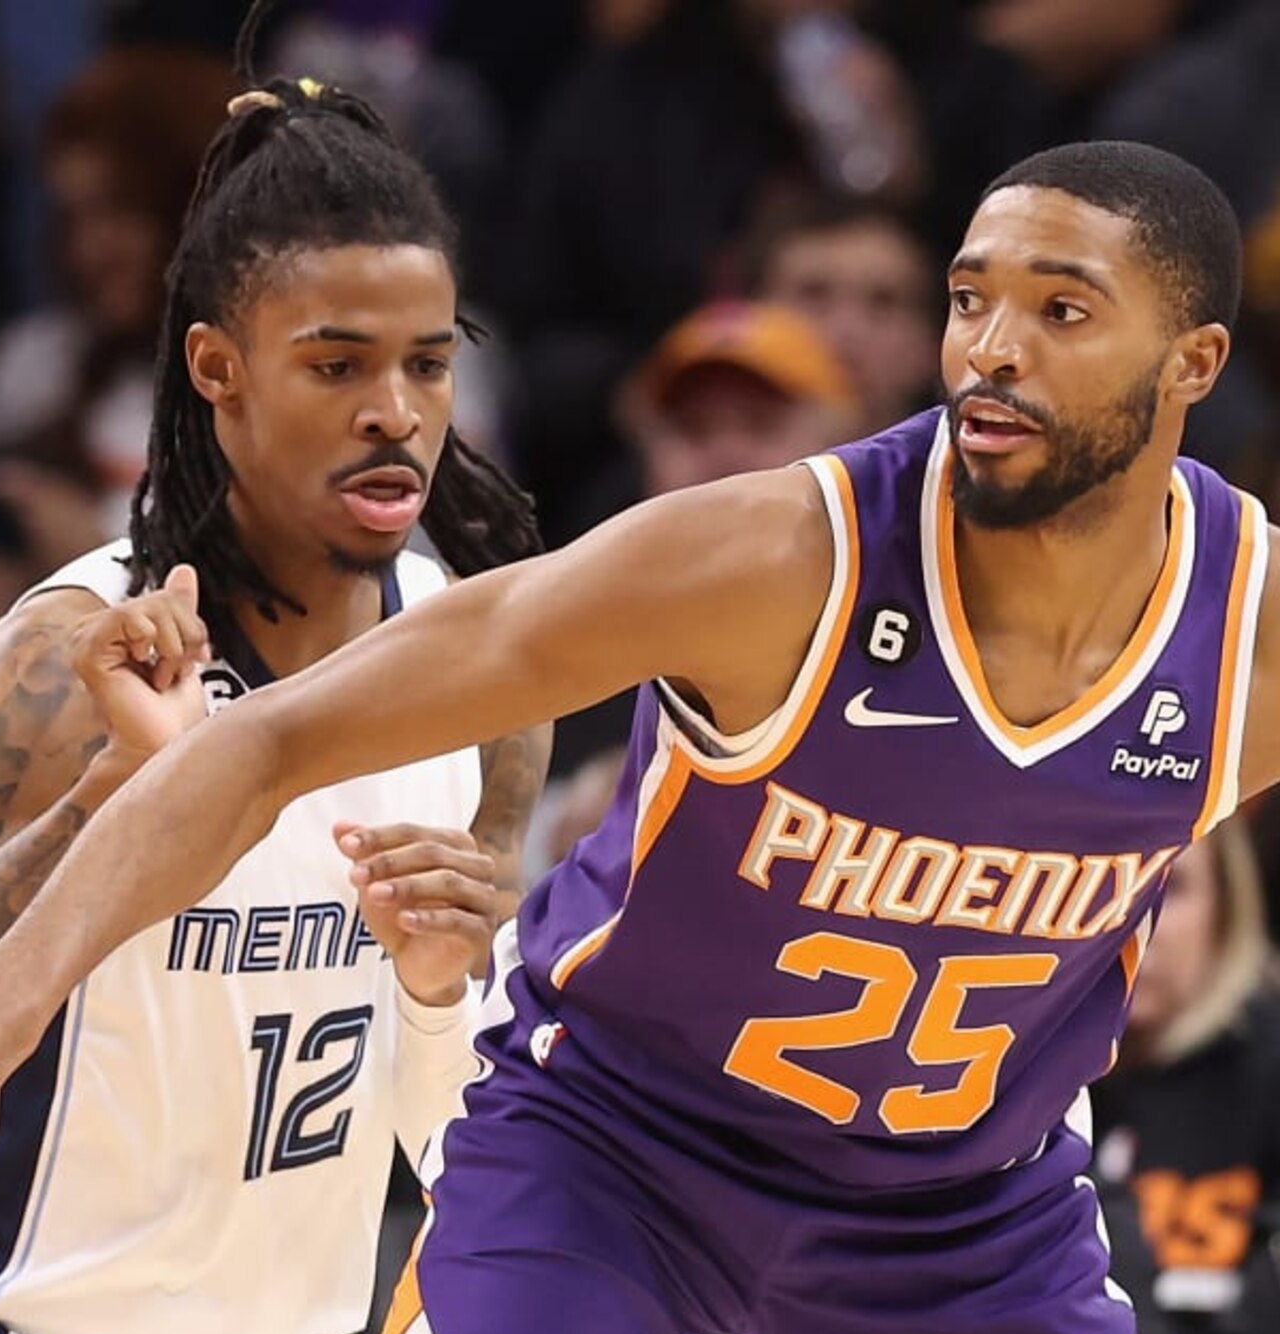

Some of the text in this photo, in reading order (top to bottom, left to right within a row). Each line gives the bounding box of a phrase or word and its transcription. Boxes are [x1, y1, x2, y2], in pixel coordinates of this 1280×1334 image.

[868, 608, 910, 662] 6
[1110, 748, 1201, 781] PayPal
[736, 779, 1180, 940] PHOENIX
[243, 1004, 374, 1182] 12
[722, 931, 1061, 1134] 25
